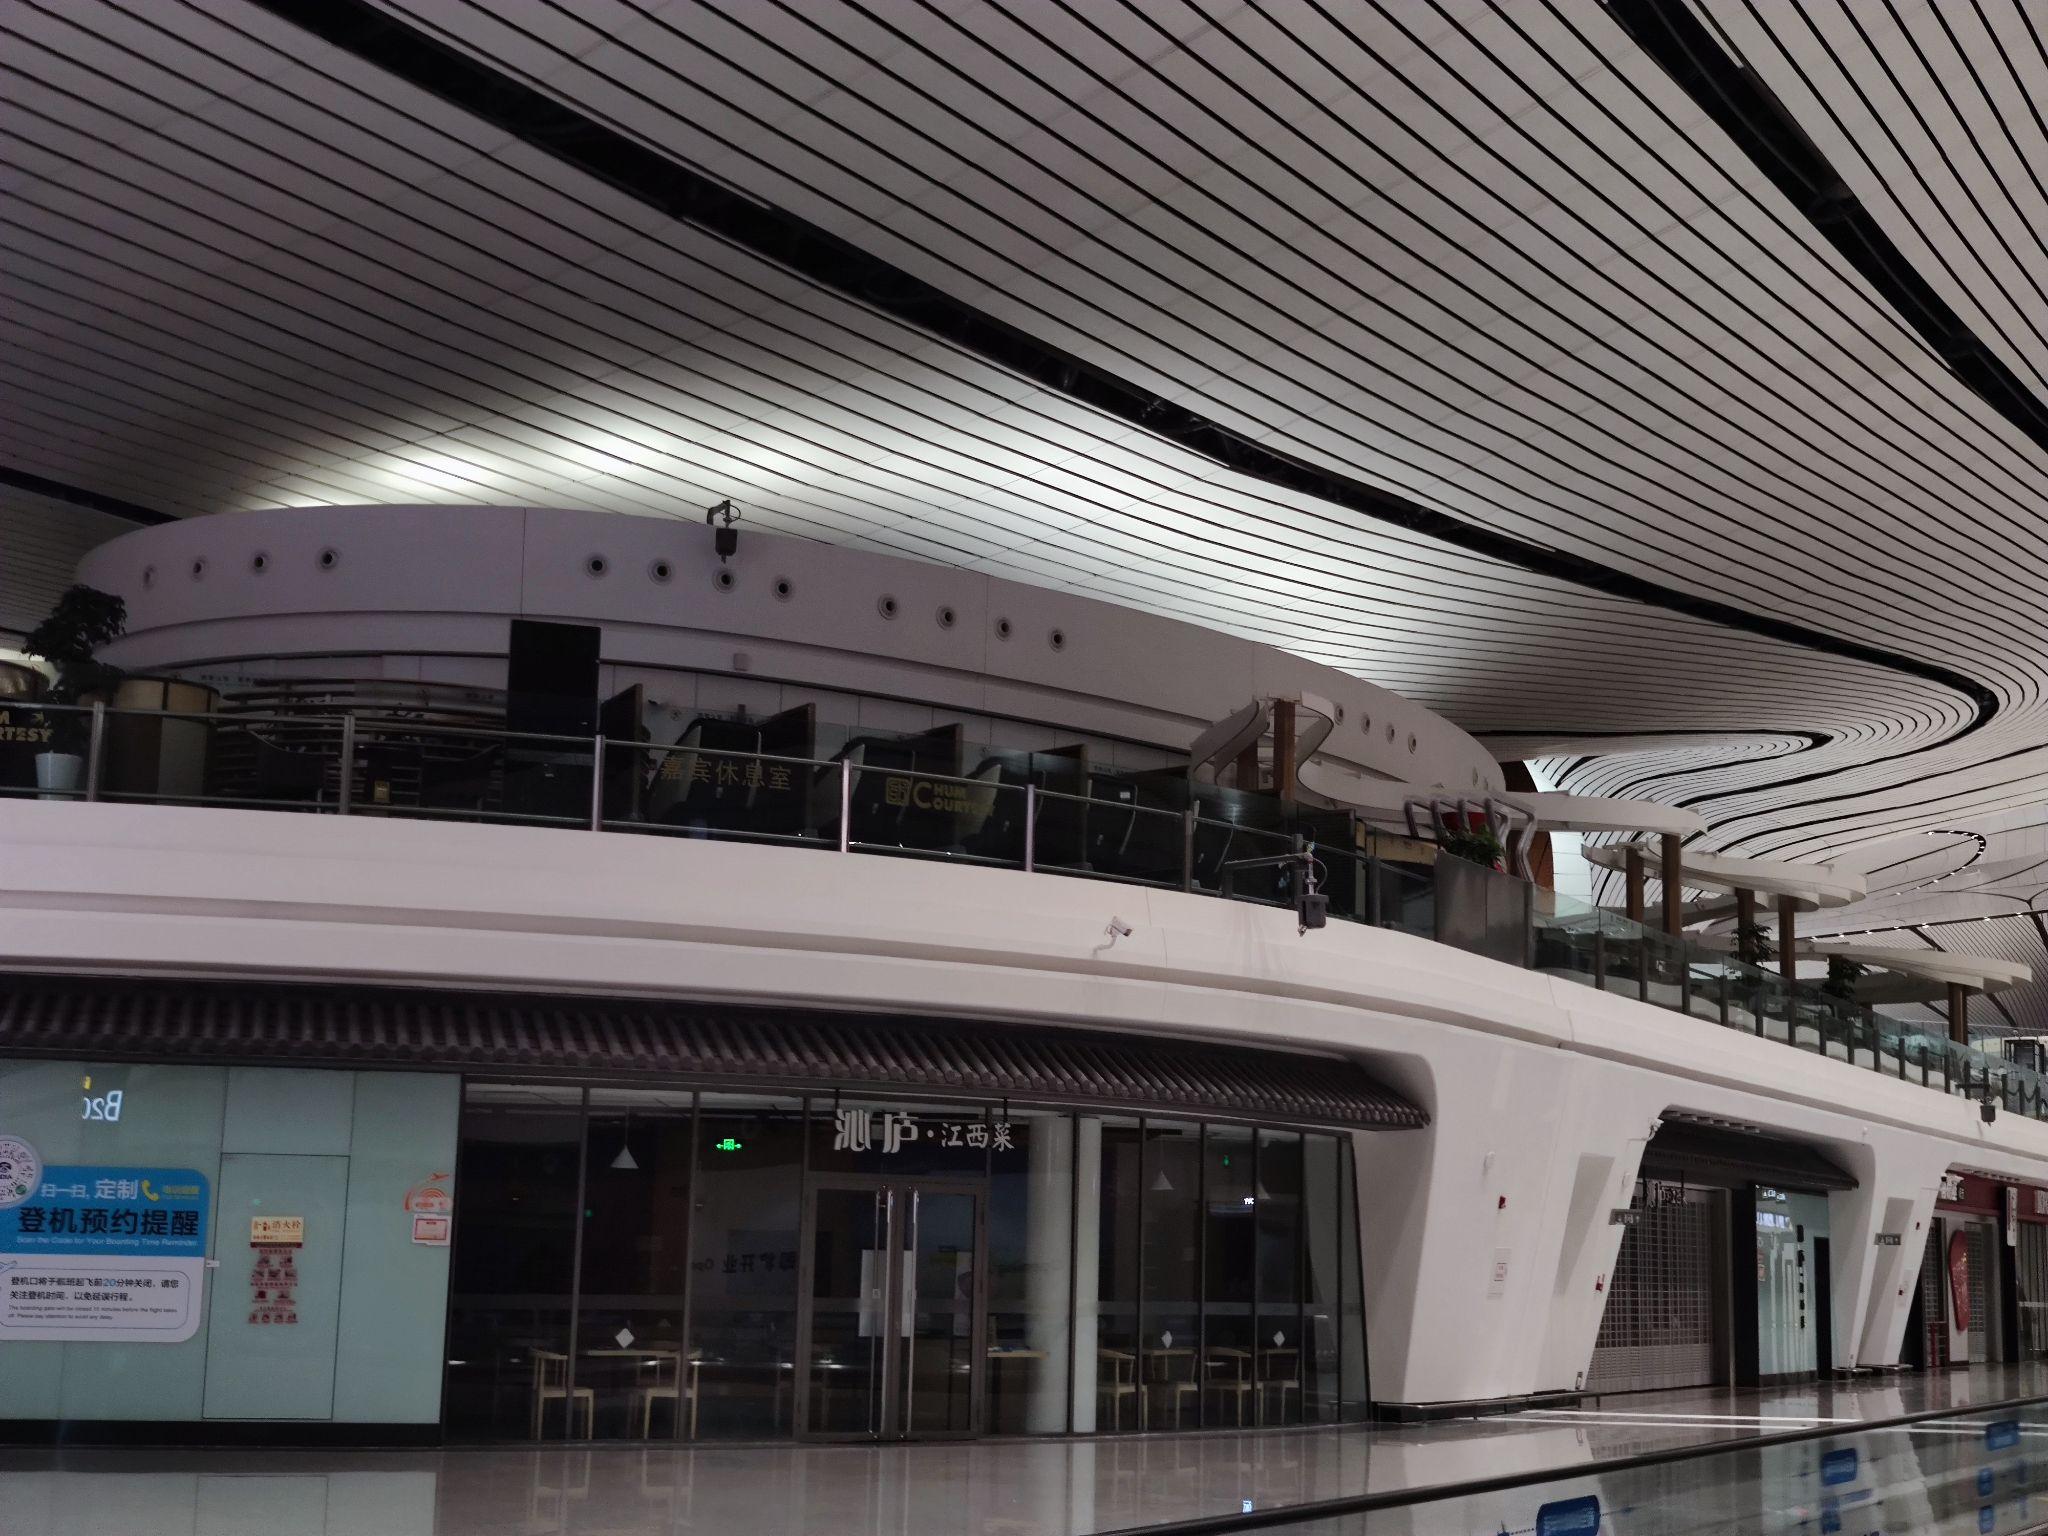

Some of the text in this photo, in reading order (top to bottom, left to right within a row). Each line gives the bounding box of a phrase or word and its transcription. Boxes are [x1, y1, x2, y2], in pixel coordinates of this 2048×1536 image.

[660, 756, 792, 791] 嘉宾休息室
[18, 1206, 199, 1236] 登机预约提醒
